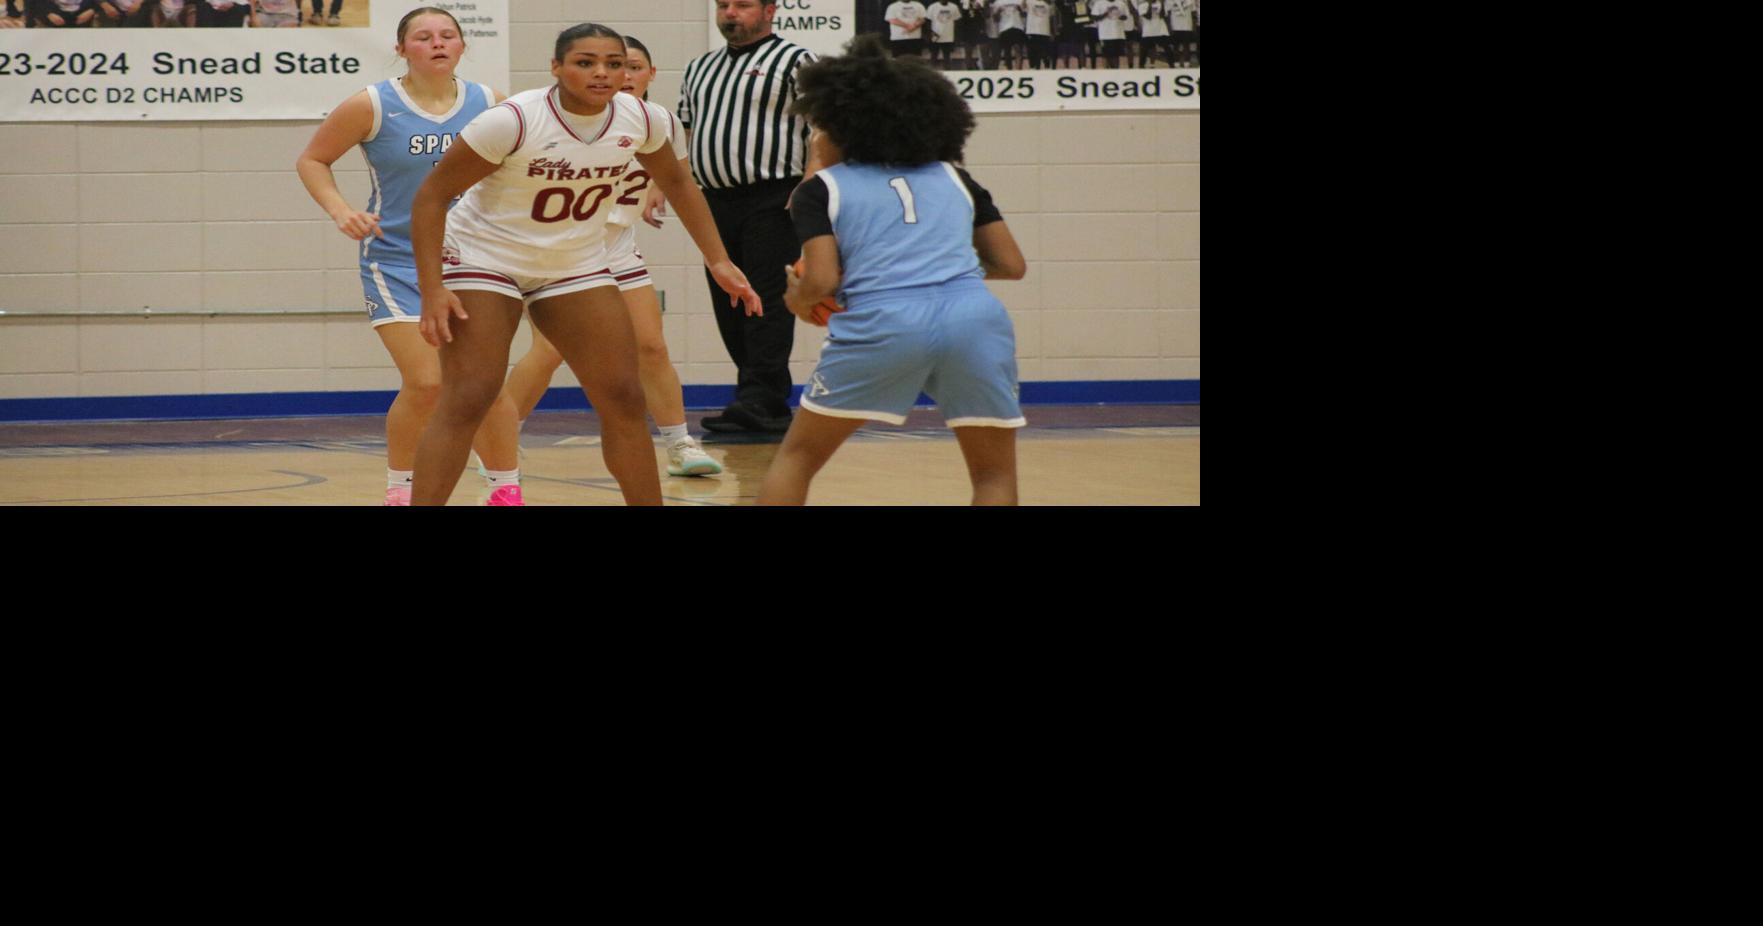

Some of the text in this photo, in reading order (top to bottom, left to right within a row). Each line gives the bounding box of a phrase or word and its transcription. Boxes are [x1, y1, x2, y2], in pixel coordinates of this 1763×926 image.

[774, 0, 811, 10] CC
[770, 16, 841, 31] HAMPS
[0, 51, 361, 76] 23-2024 Snead State
[30, 87, 244, 104] ACCC D2 CHAMPS
[1056, 75, 1161, 99] Snead
[409, 132, 461, 155] SPA
[528, 157, 571, 170] Lady
[615, 169, 650, 206] 2
[531, 184, 612, 223] 00
[888, 176, 919, 224] 1
